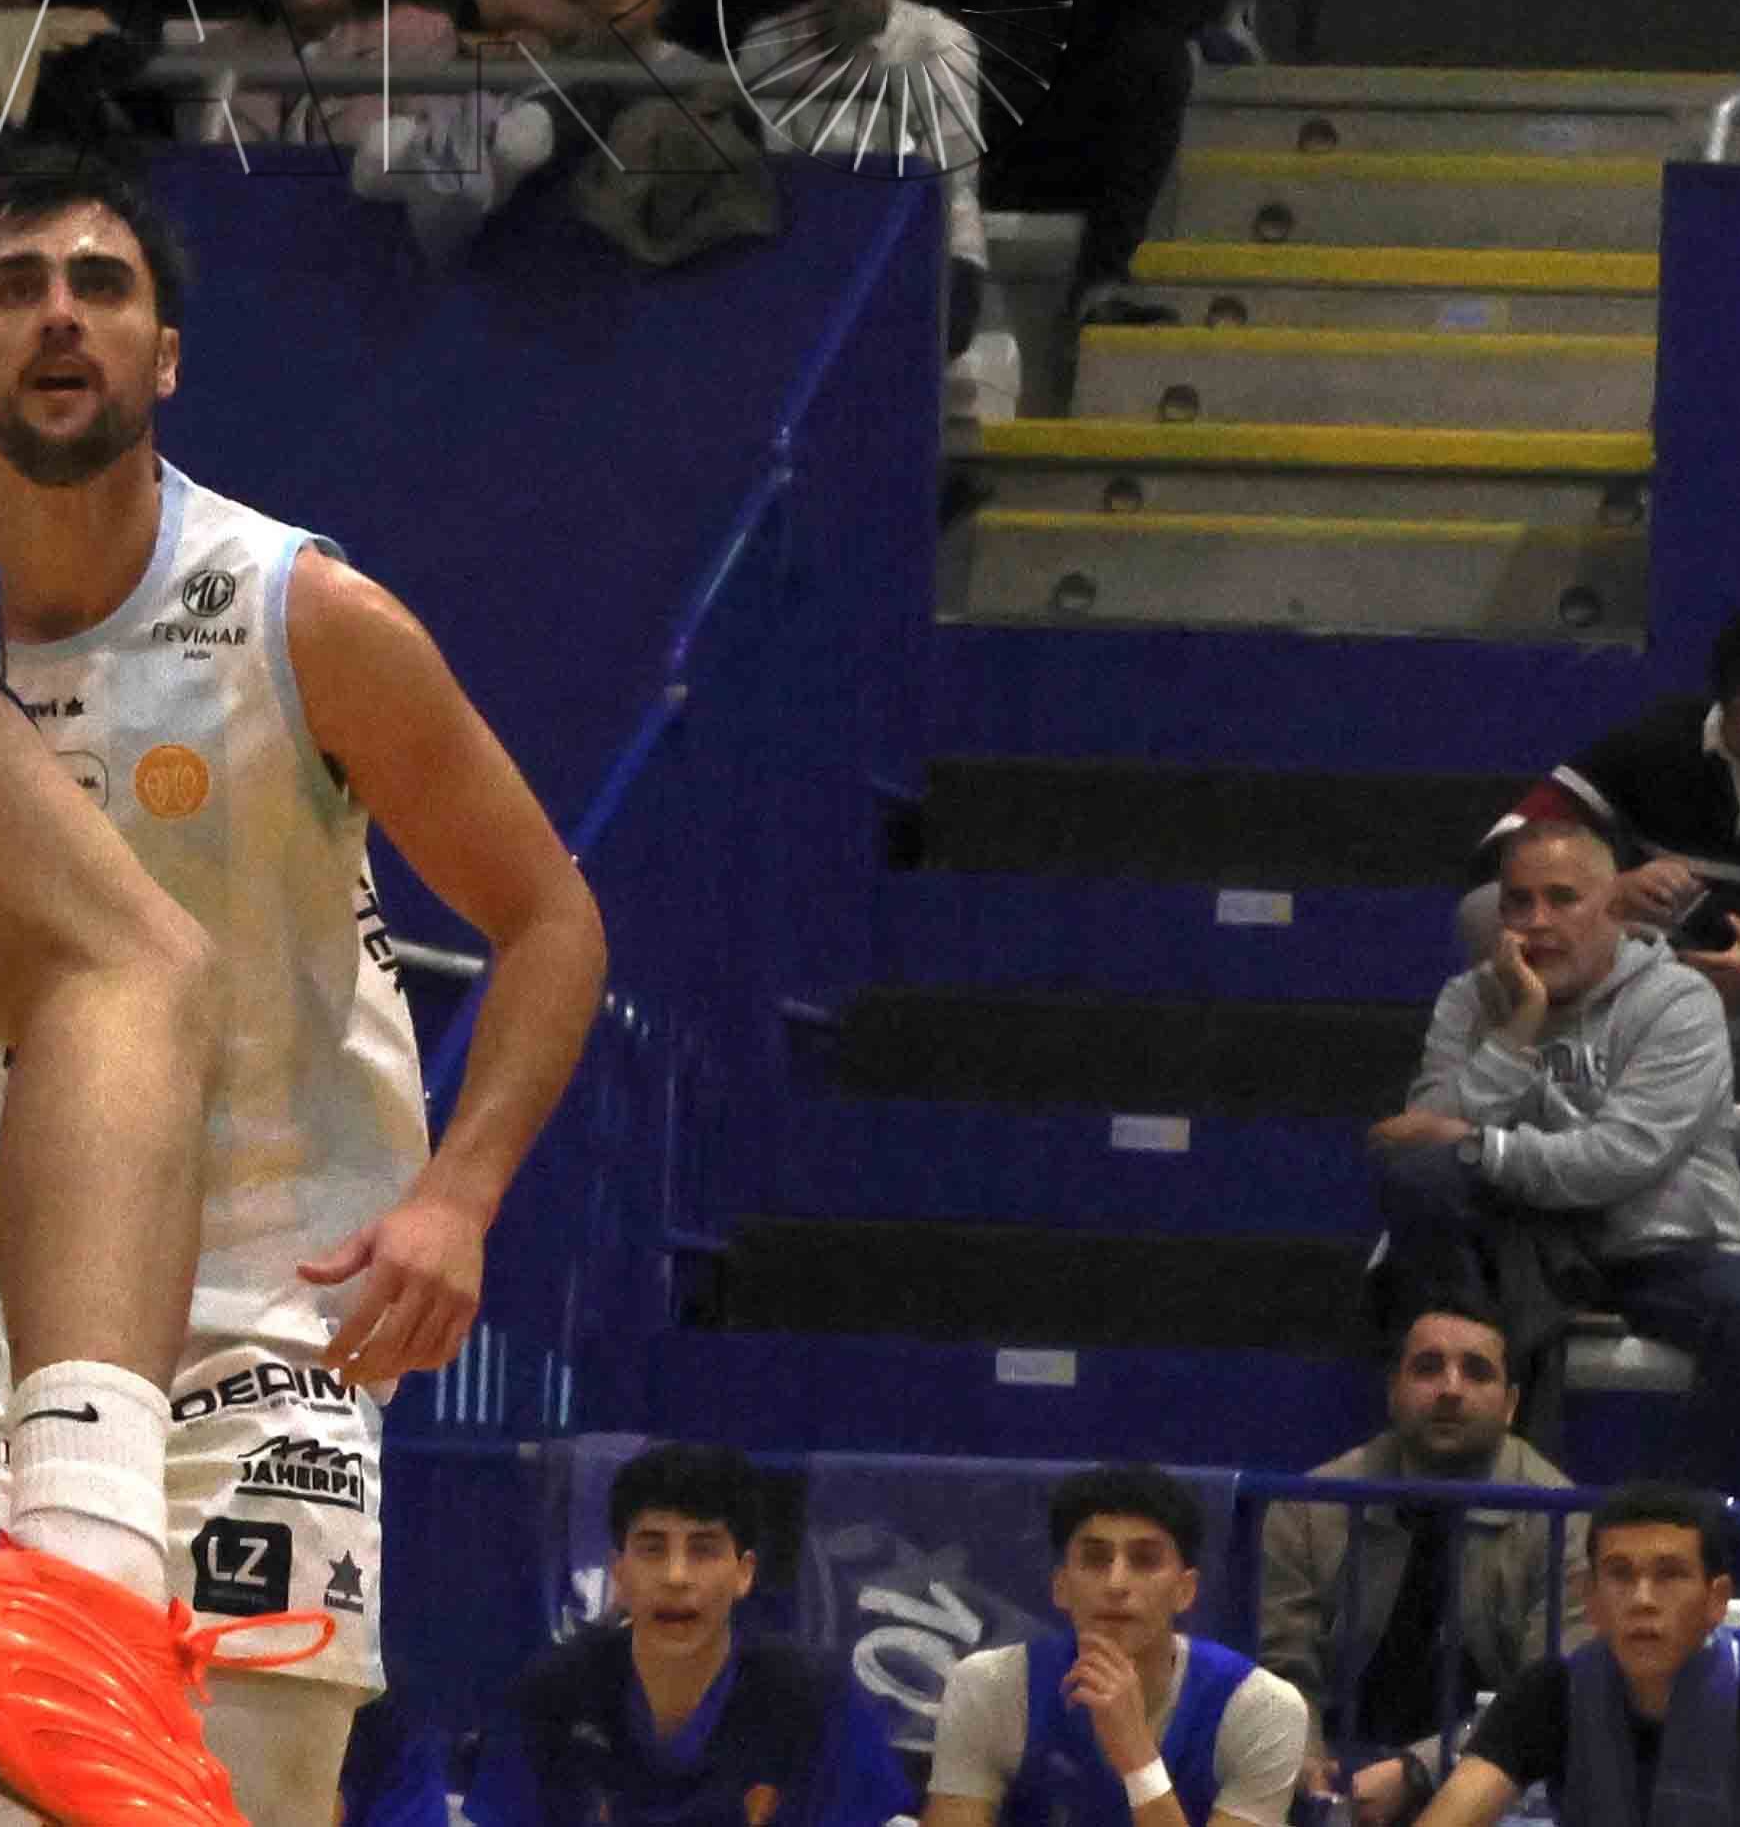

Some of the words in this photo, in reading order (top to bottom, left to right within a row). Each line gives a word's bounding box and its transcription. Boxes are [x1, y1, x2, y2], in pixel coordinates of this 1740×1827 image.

[183, 571, 236, 617] MG
[152, 622, 246, 646] FEVIMAR
[208, 1535, 269, 1587] LZ
